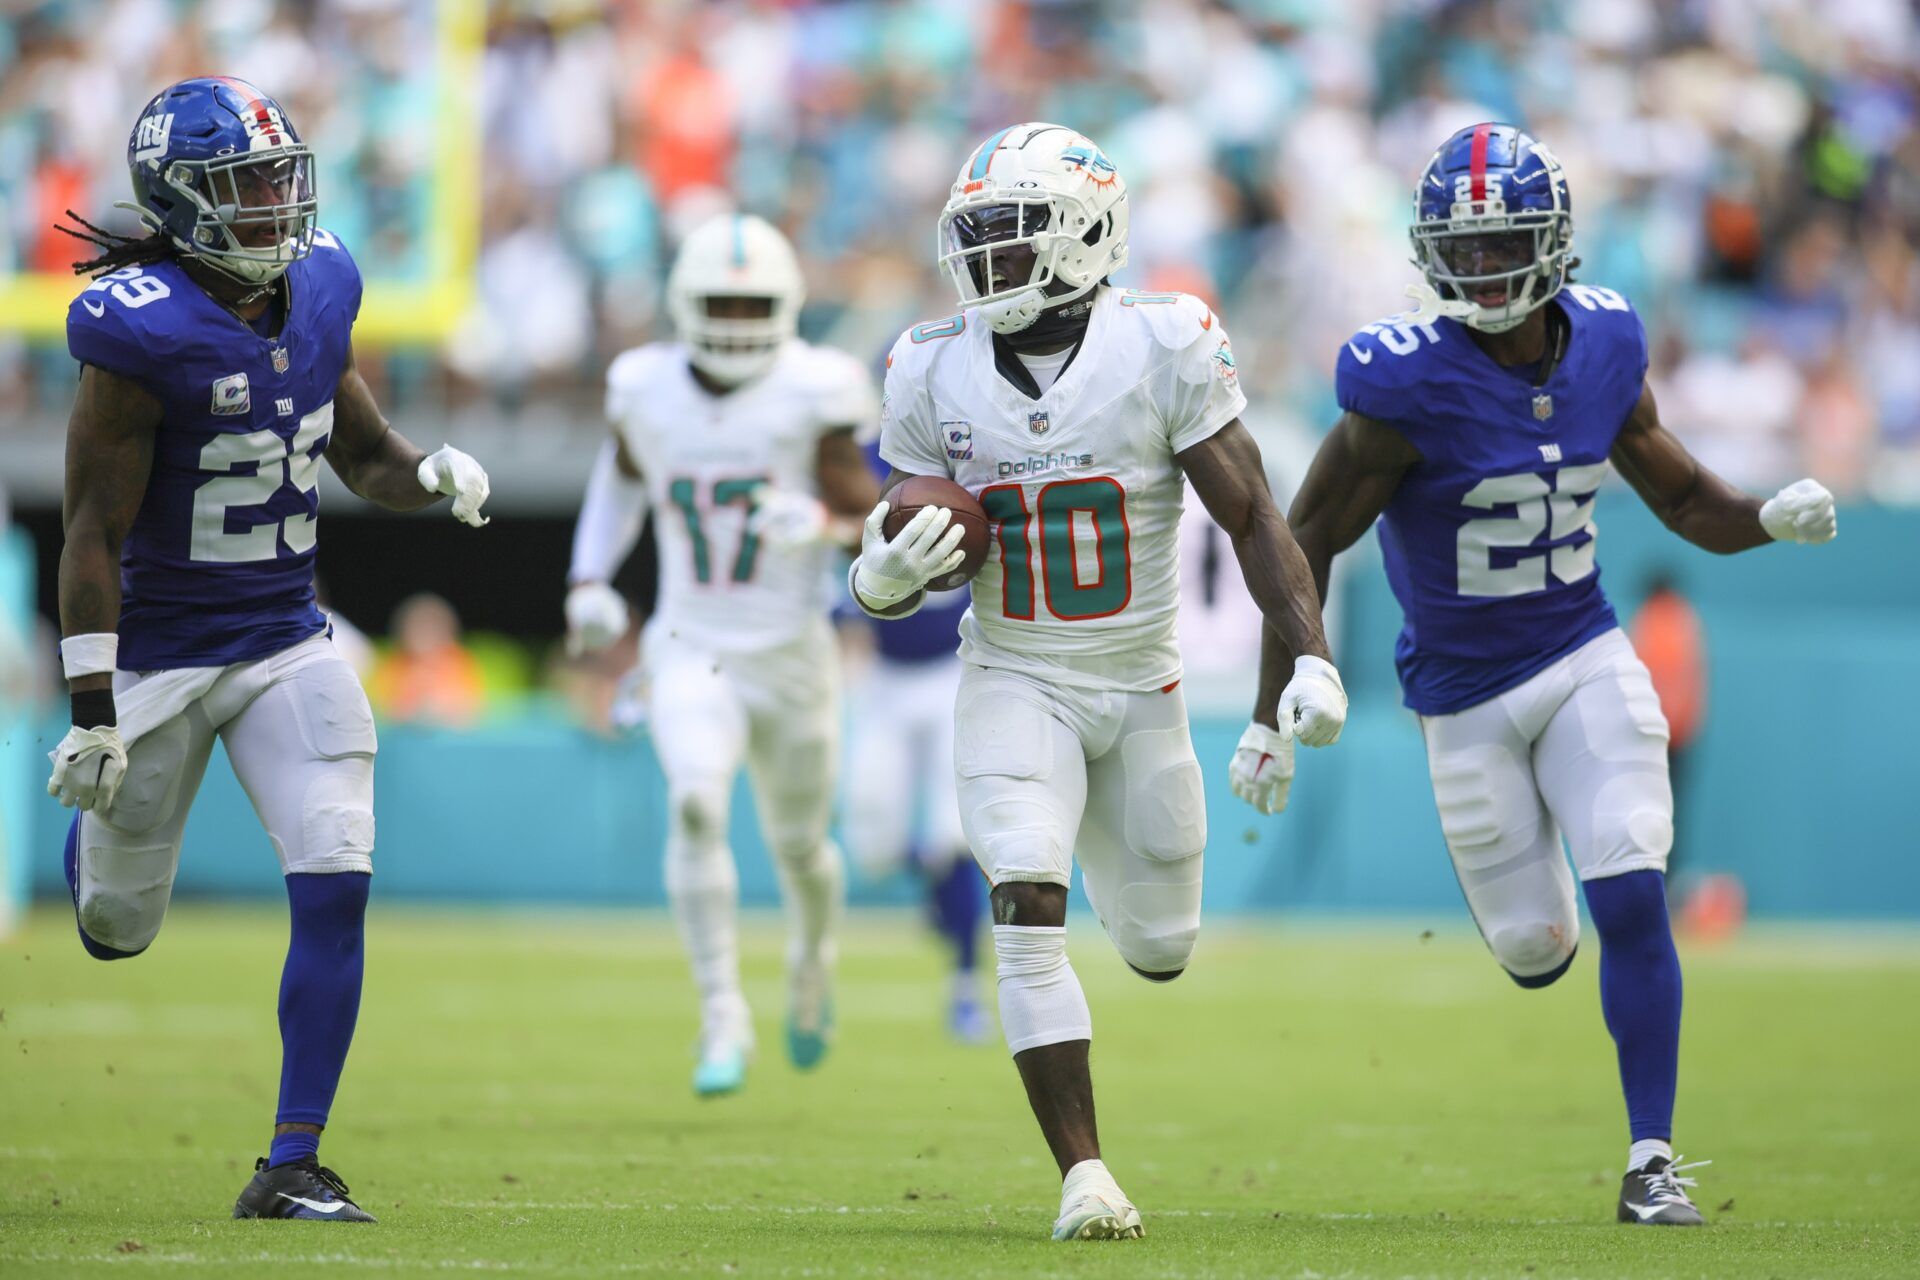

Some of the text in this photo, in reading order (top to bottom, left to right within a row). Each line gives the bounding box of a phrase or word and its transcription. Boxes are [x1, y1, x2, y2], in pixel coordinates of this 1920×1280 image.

[240, 107, 285, 137] 29
[1455, 173, 1504, 203] 25
[85, 267, 170, 309] 29
[997, 453, 1093, 475] Dolphins
[668, 474, 772, 586] 17
[1456, 457, 1609, 597] 25
[977, 476, 1132, 622] 10
